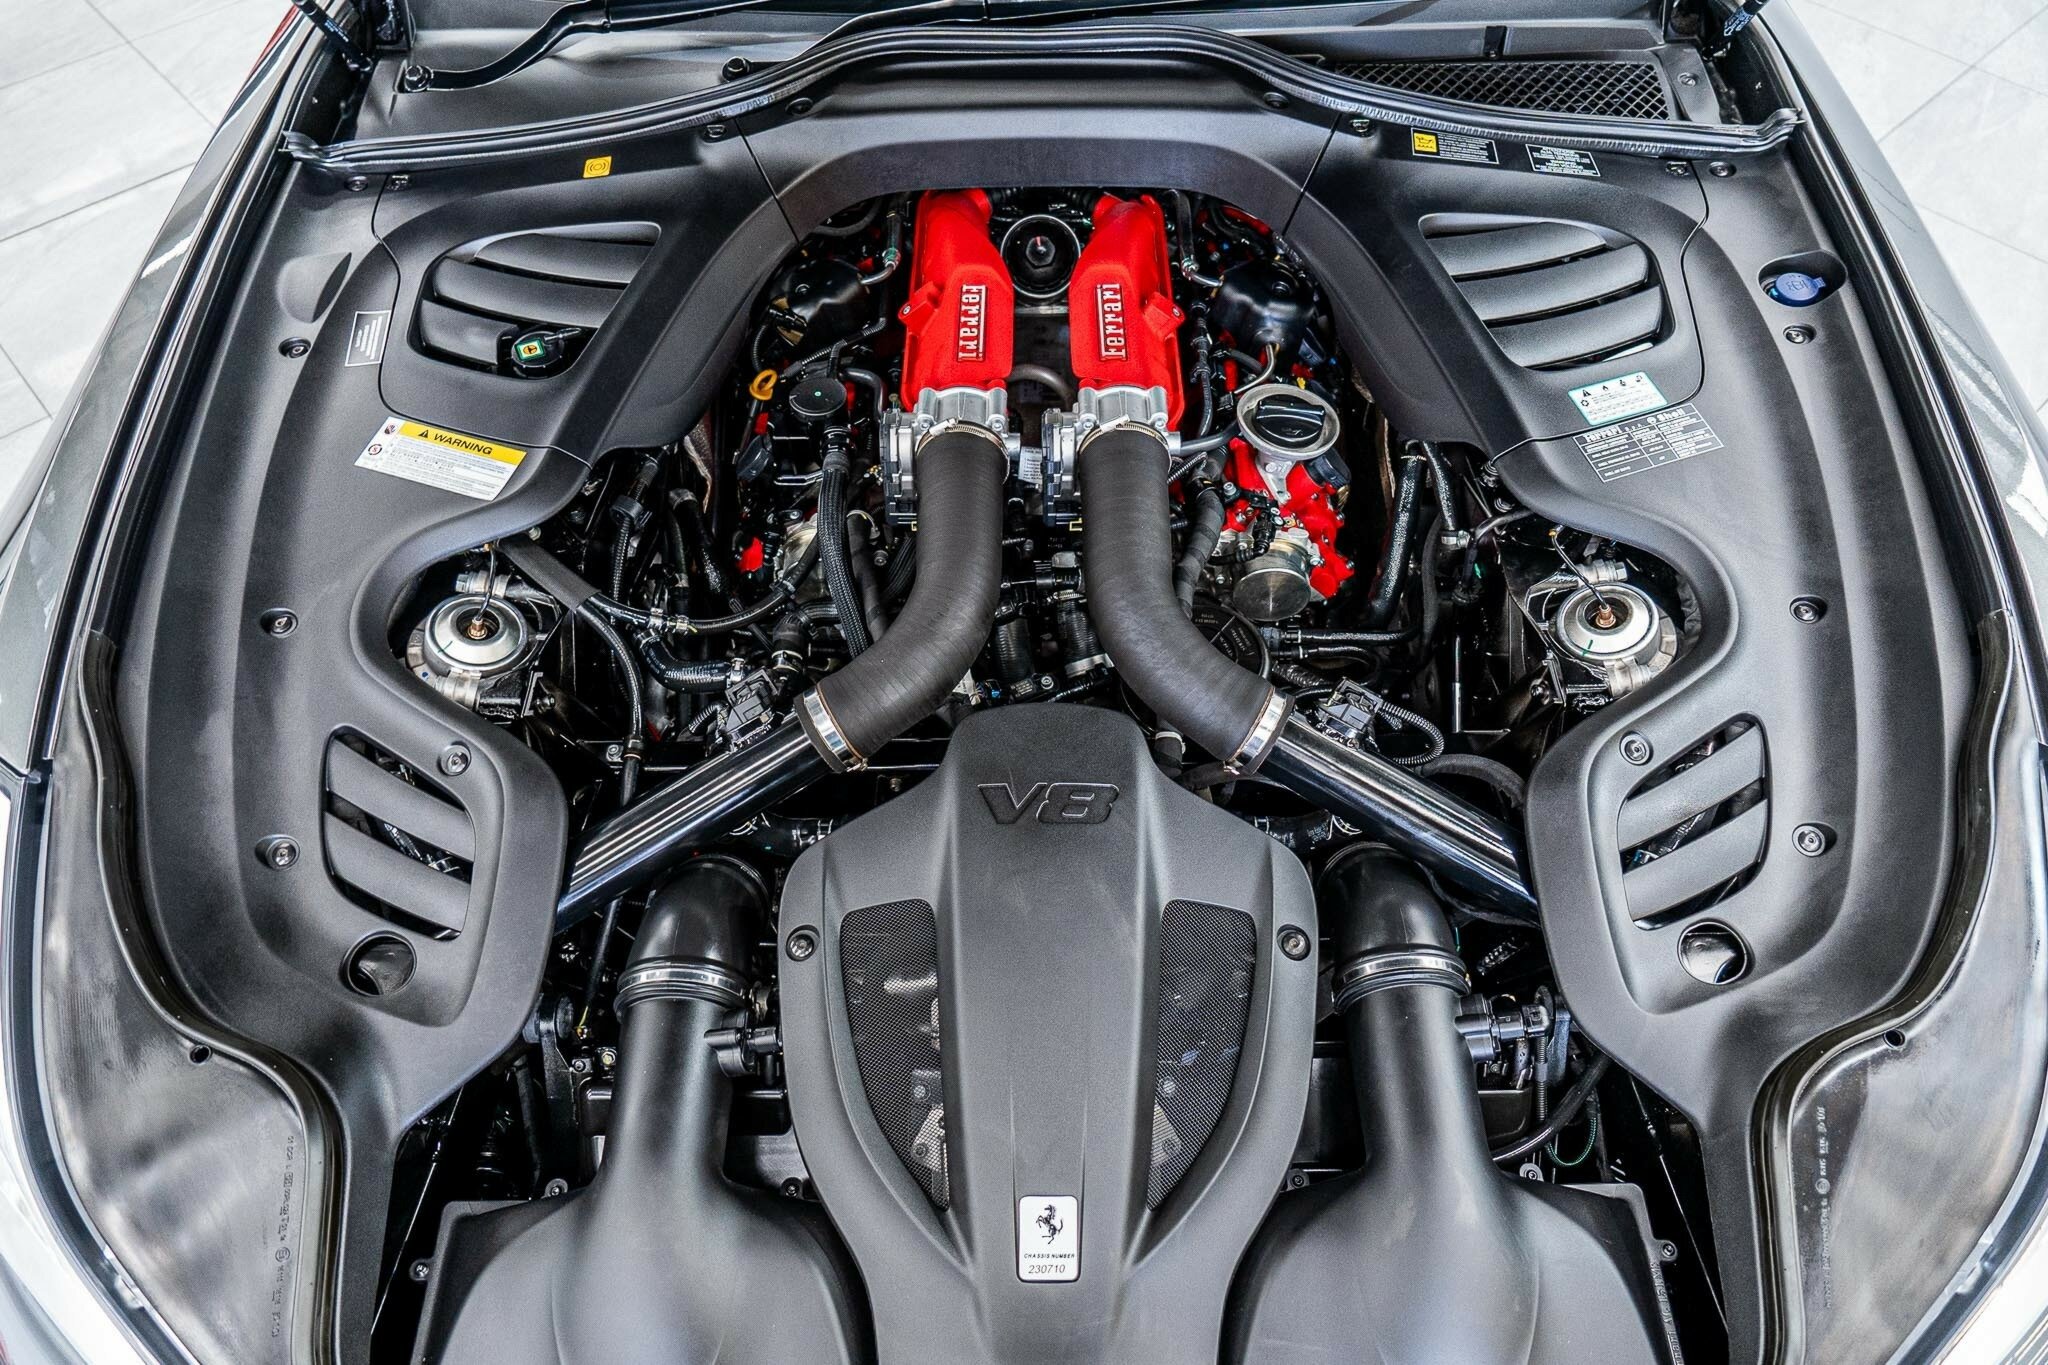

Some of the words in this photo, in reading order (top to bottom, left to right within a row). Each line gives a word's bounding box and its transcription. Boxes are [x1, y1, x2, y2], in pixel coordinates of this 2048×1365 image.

[958, 284, 987, 361] Ferrari
[1096, 283, 1126, 360] Ferrari
[1658, 409, 1685, 422] Shell
[433, 433, 493, 455] WARNING
[977, 782, 1120, 825] V8
[1028, 1264, 1066, 1274] 230710
